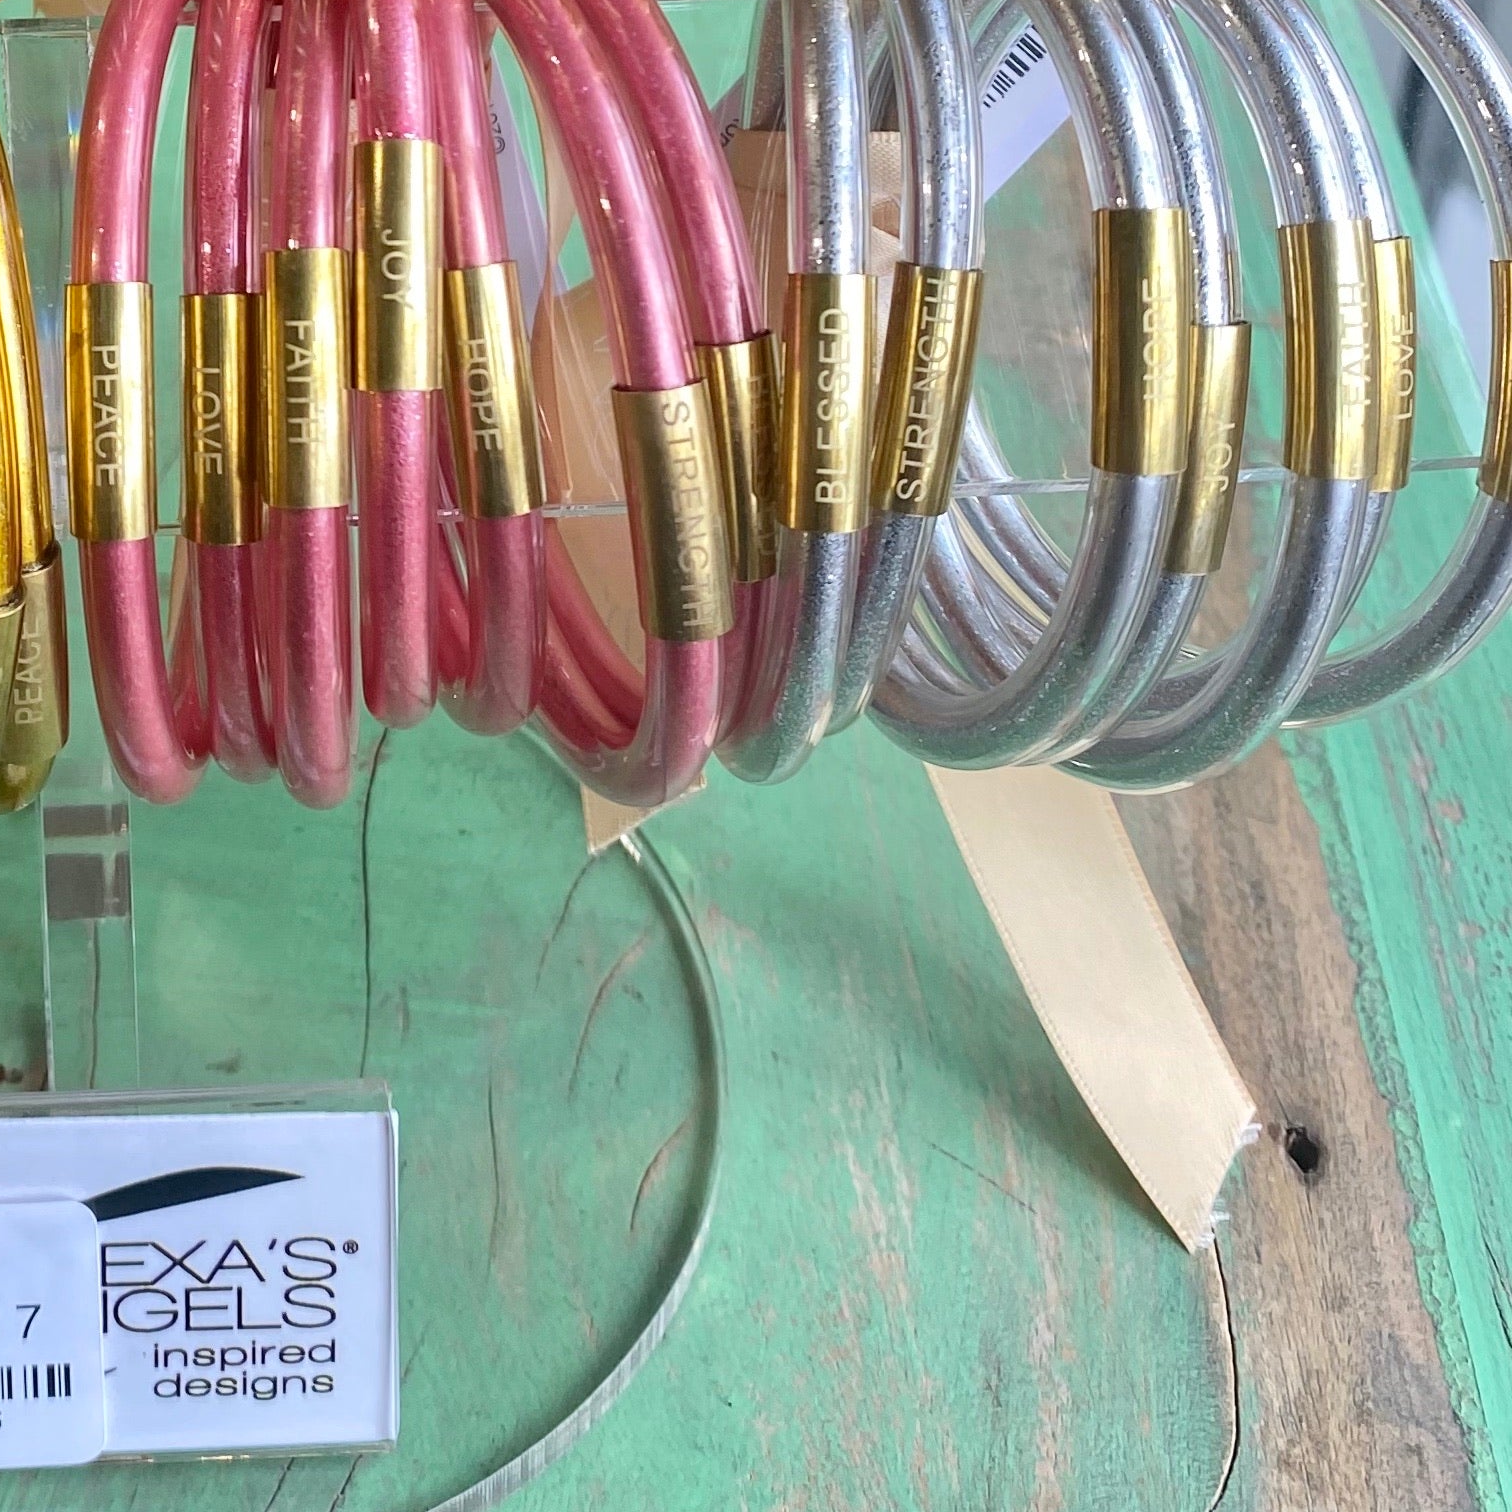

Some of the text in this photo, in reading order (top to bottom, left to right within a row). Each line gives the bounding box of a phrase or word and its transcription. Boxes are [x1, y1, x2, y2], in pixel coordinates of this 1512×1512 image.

[379, 228, 416, 310] JOY
[284, 319, 319, 445] FAITH
[459, 337, 504, 452] HOPE
[814, 306, 851, 505] BLESSED
[896, 276, 958, 504] STRENGTH
[1337, 281, 1372, 420] FAITH
[1390, 311, 1415, 421] LOVE
[90, 344, 124, 488] PEACE
[192, 366, 224, 476] LOVE
[661, 399, 714, 627] STRENGTH
[14, 616, 44, 726] PEACE
[15, 1304, 42, 1340] 7
[153, 1338, 338, 1370] inspired
[153, 1370, 336, 1401] designs
